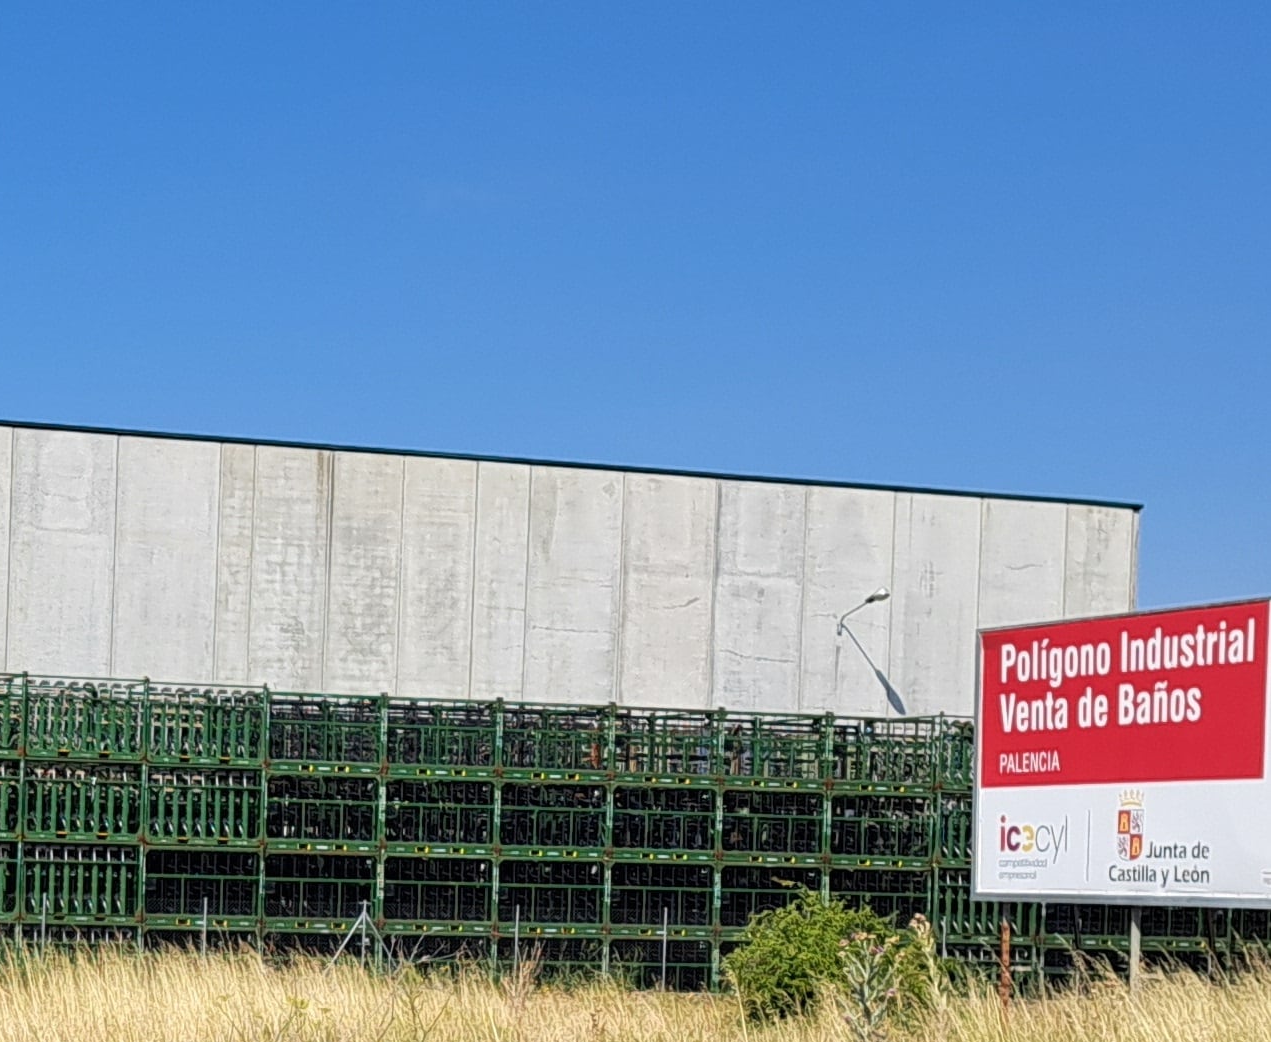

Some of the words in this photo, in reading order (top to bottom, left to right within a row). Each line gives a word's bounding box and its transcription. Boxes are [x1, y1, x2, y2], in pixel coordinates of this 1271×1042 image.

[1000, 639, 1110, 688] Polígono
[1120, 618, 1255, 673] Industrial
[1000, 692, 1068, 733] Venta
[1078, 687, 1108, 728] de
[1118, 680, 1202, 726] Baños
[999, 750, 1061, 774] PALENCIA
[1146, 841, 1187, 859] Junta
[1191, 841, 1210, 859] de
[1109, 864, 1157, 882] Castilla
[1161, 868, 1170, 888] y
[1174, 864, 1210, 883] León
